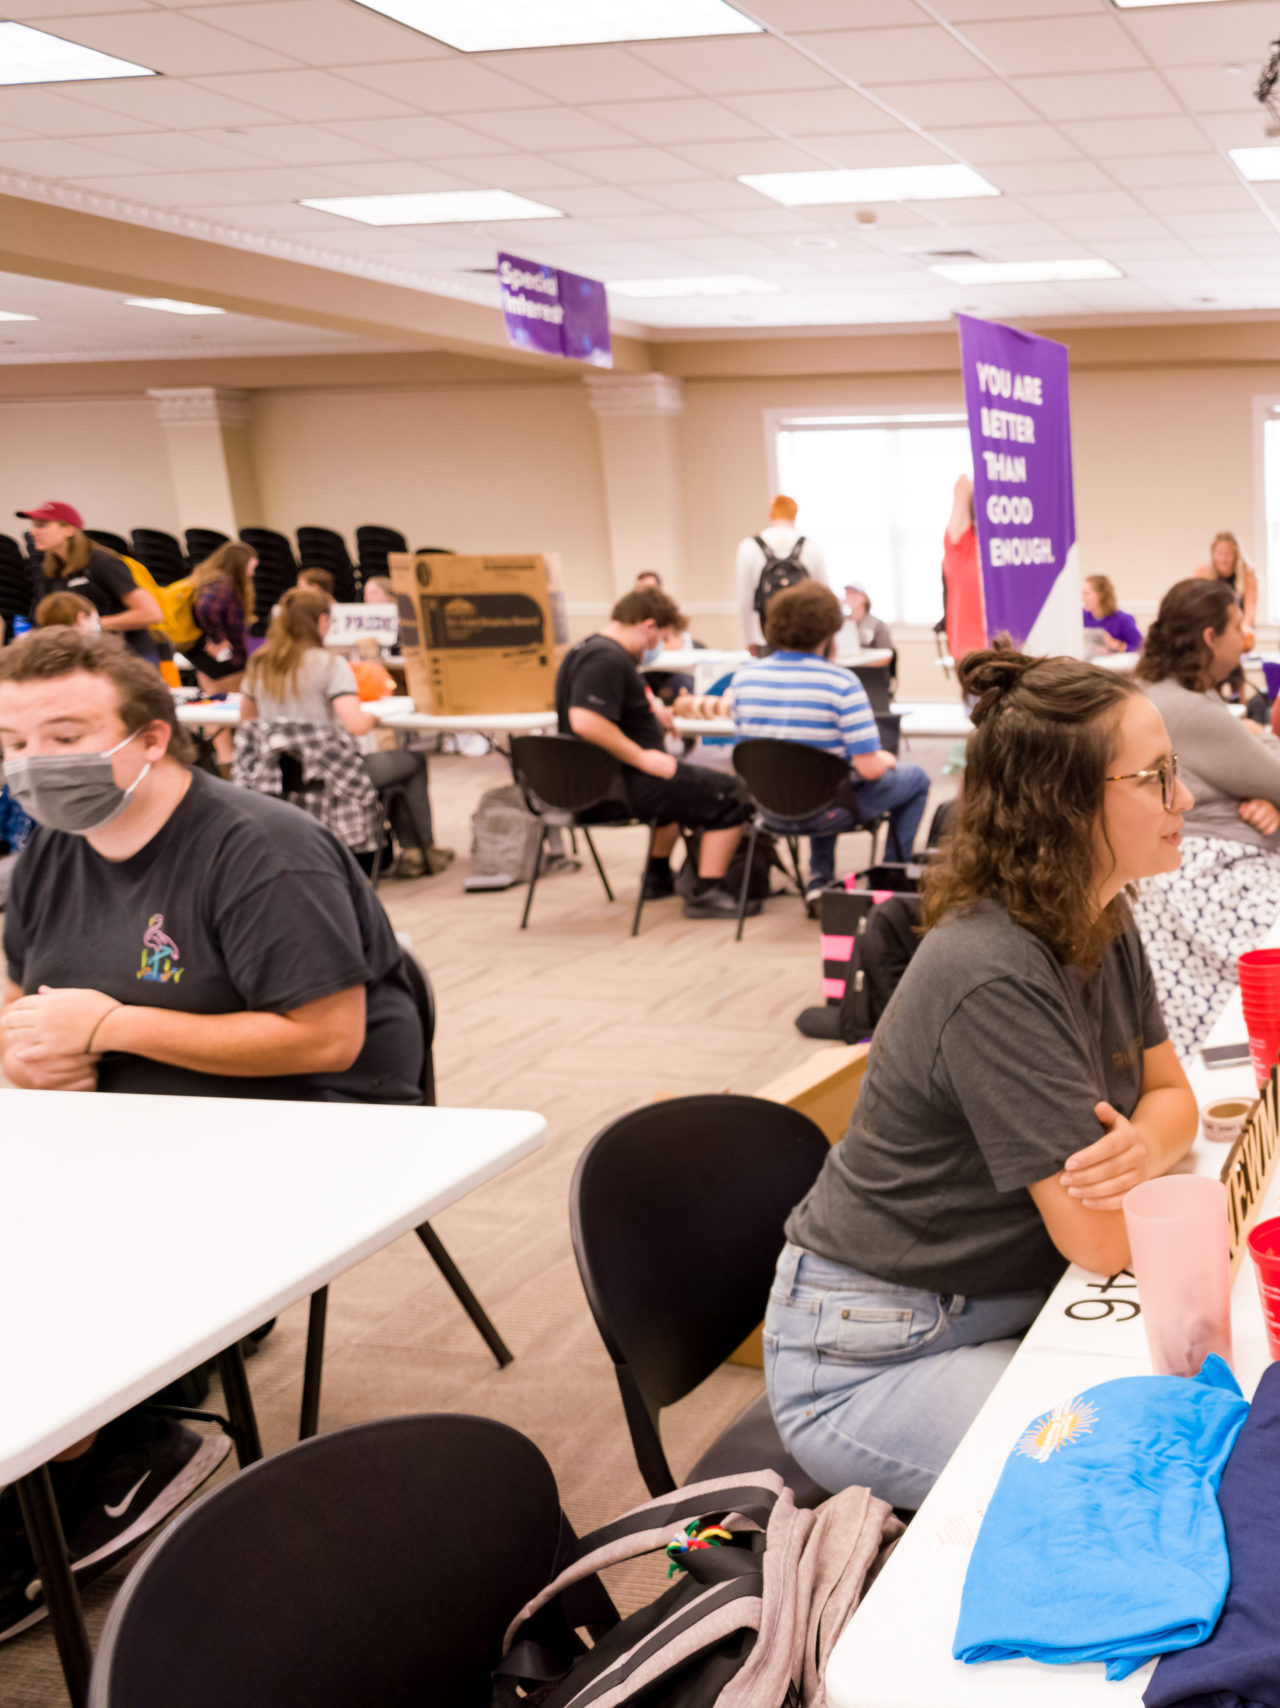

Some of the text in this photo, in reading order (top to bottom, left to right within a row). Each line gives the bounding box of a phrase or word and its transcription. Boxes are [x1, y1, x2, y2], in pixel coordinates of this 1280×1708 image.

[500, 261, 557, 296] Special
[976, 361, 1043, 406] YOU ARE
[980, 406, 1035, 444] BETTER
[982, 451, 1027, 483] THAN
[986, 494, 1034, 525] GOOD
[989, 536, 1056, 567] ENOUGH.
